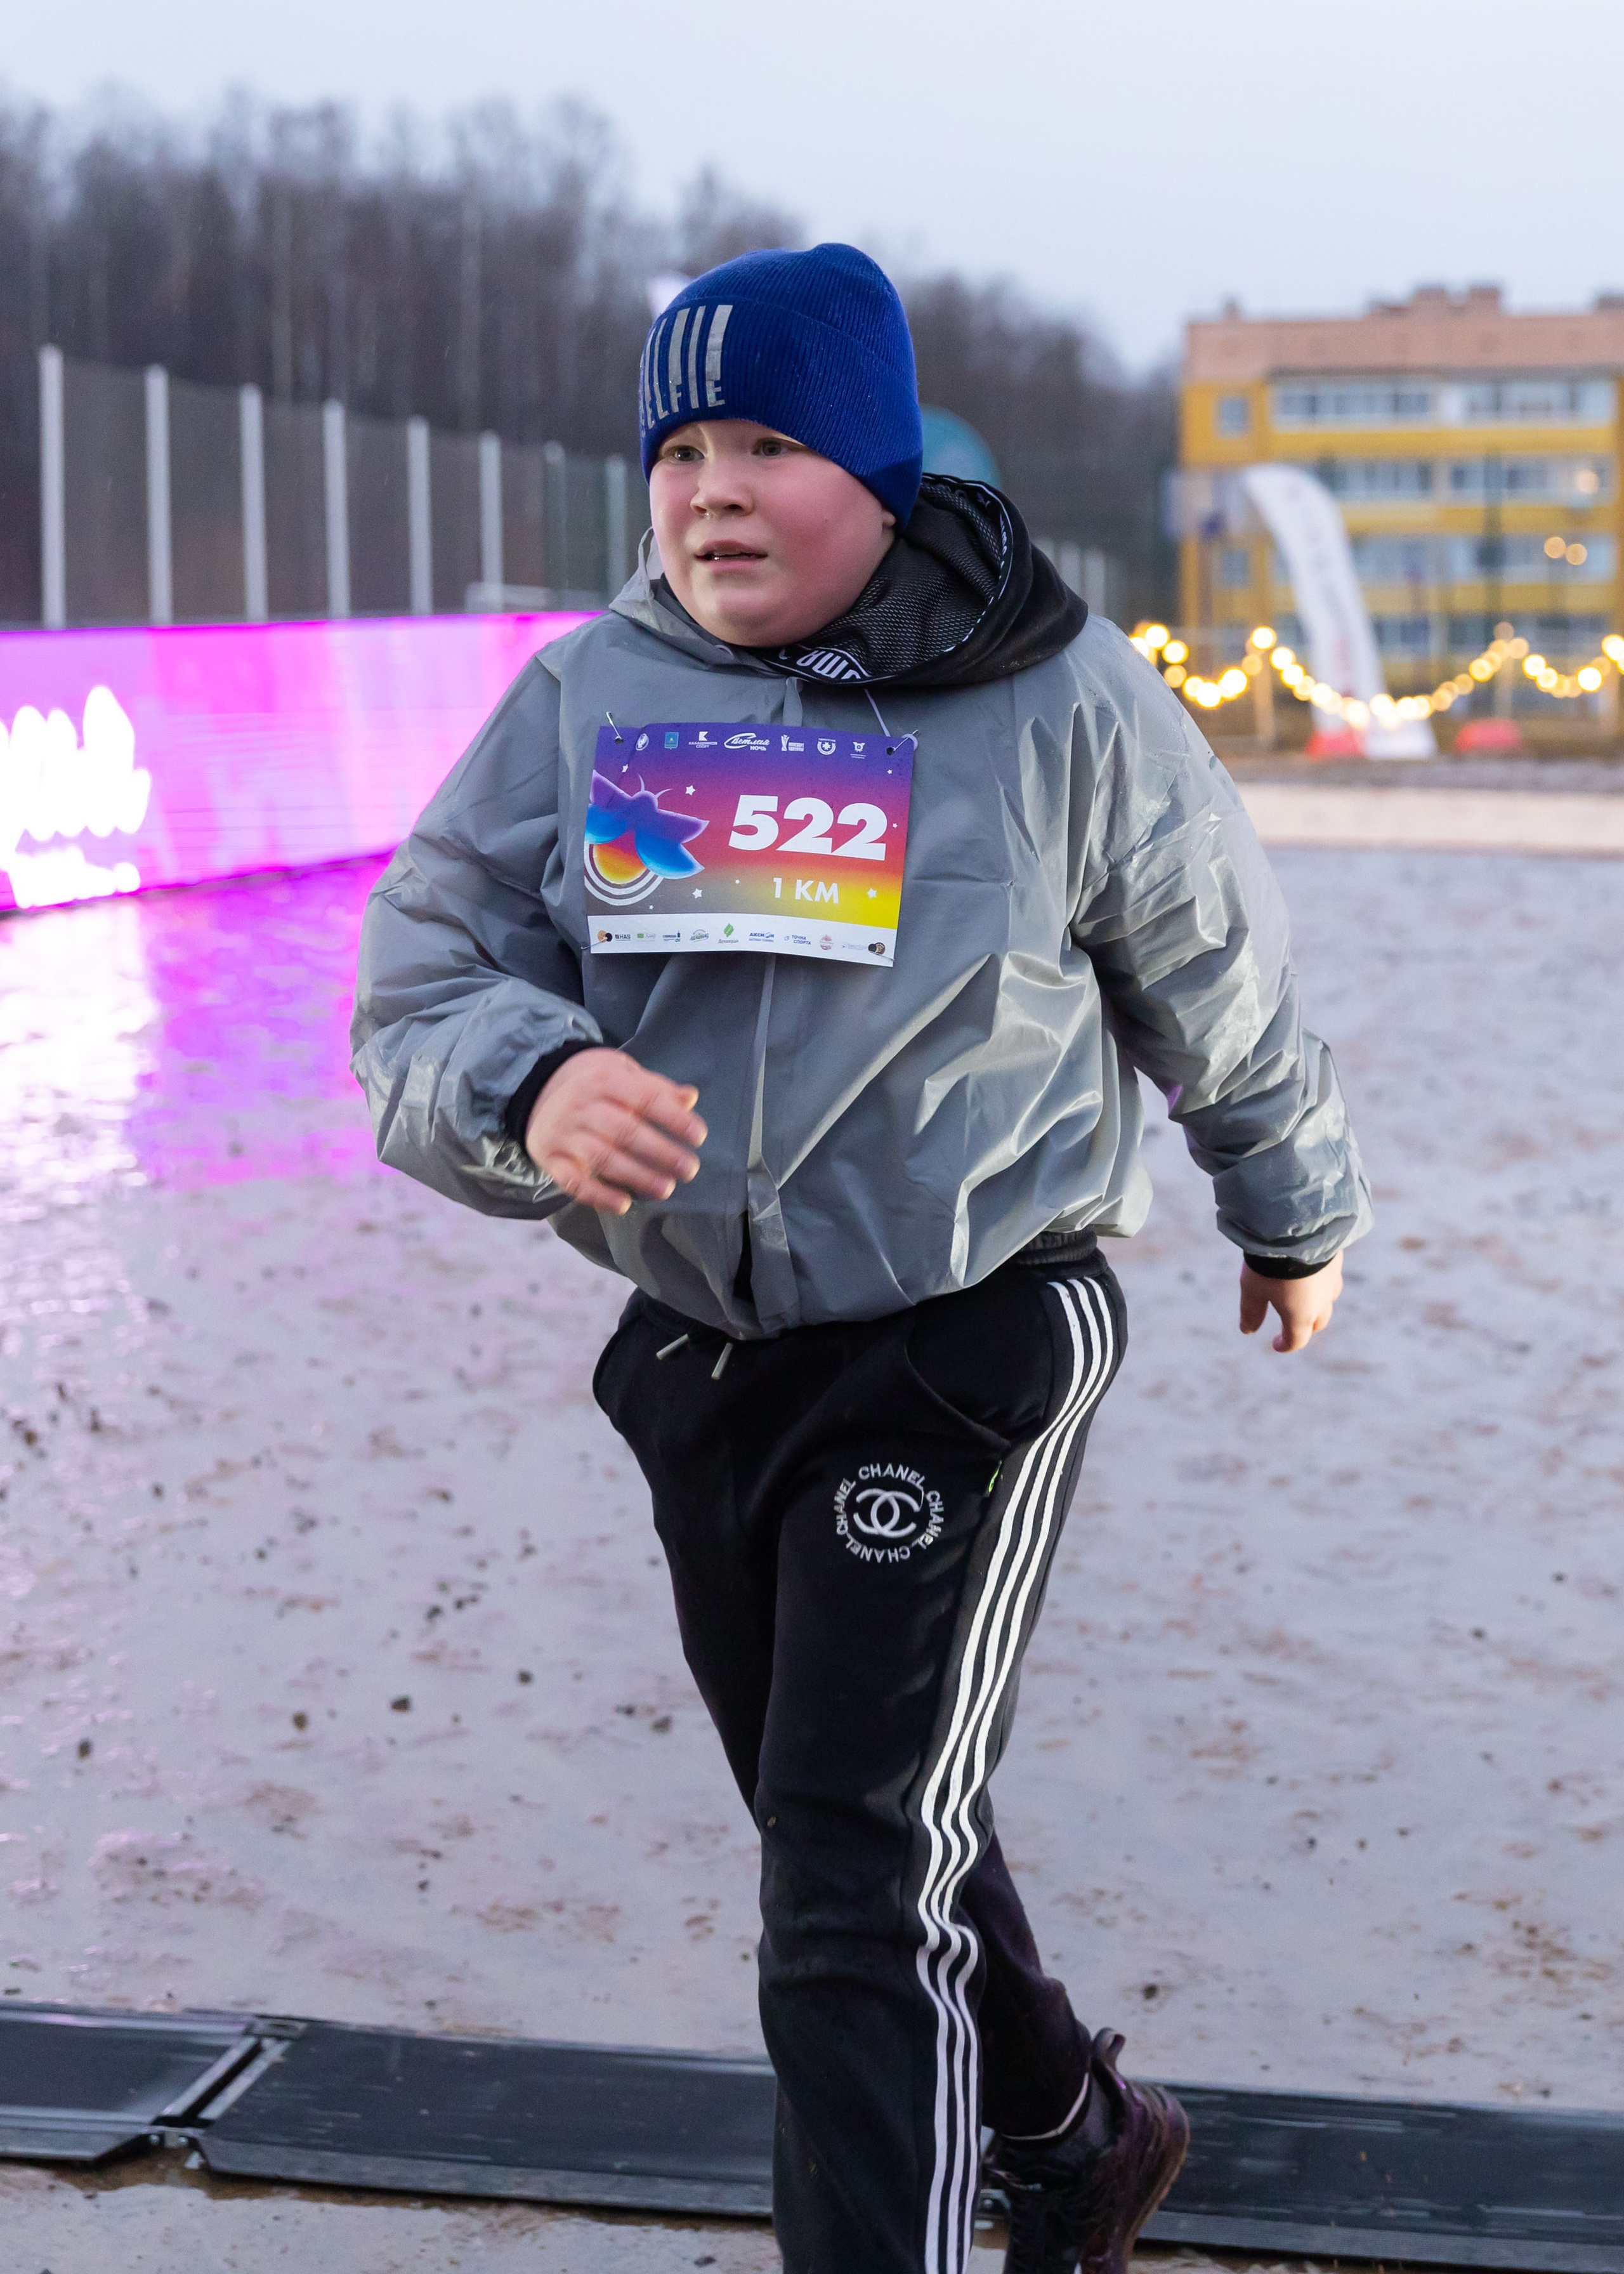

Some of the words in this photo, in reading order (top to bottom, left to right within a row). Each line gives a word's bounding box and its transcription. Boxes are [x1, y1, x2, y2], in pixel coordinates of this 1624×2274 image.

[724, 732, 770, 749] Светлая
[728, 794, 888, 861] 522
[773, 877, 782, 898] 1
[858, 1462, 925, 1489] CHANEL
[834, 1478, 856, 1535] CHANEL
[912, 1490, 945, 1549] CHANEL
[846, 1534, 910, 1563] CHANEL
